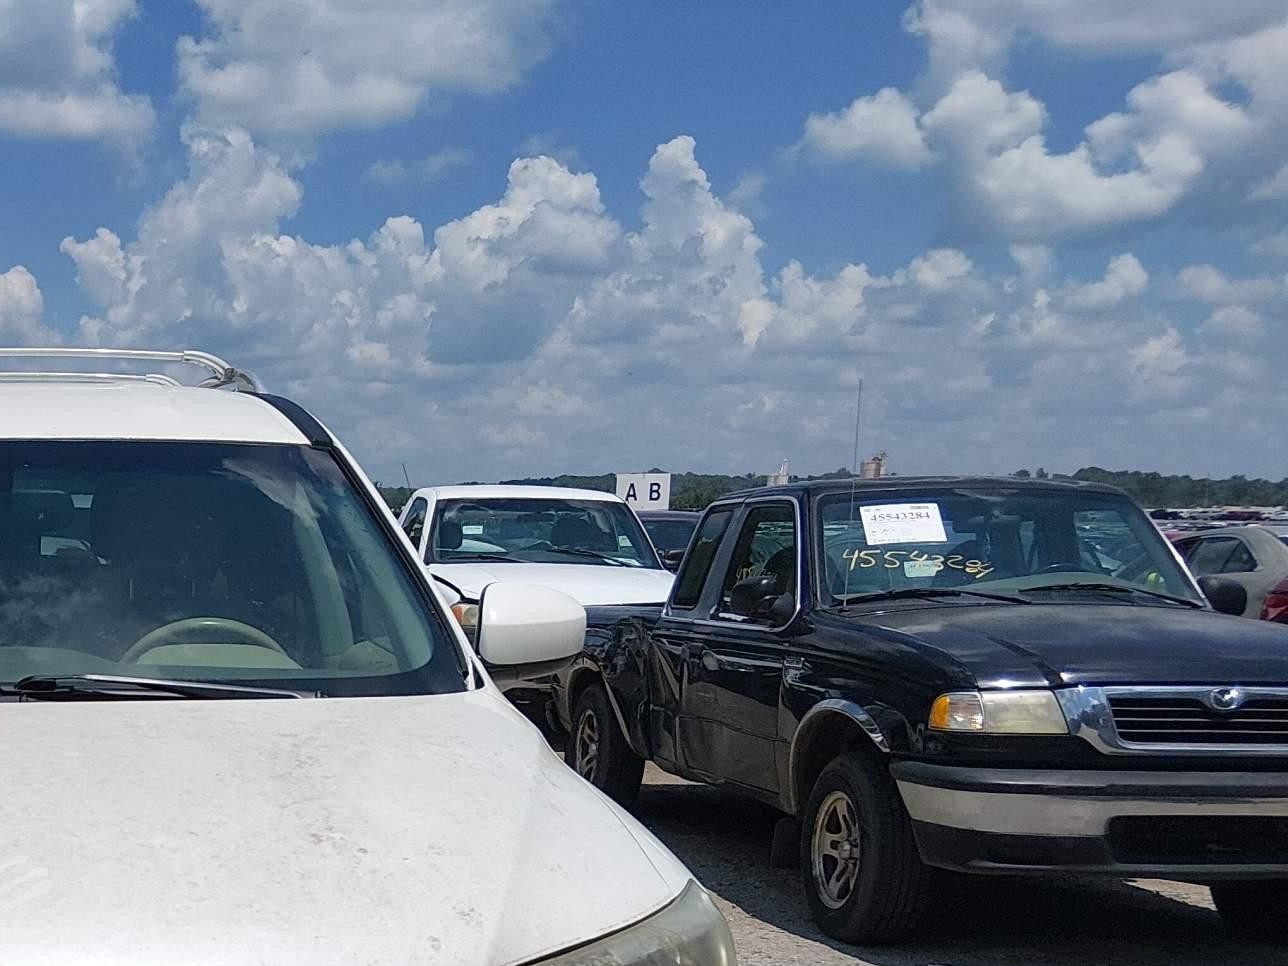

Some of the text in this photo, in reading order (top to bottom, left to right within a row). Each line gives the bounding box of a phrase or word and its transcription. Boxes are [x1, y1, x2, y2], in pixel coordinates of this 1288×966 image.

[625, 482, 661, 501] A B
[870, 511, 931, 522] 45543284
